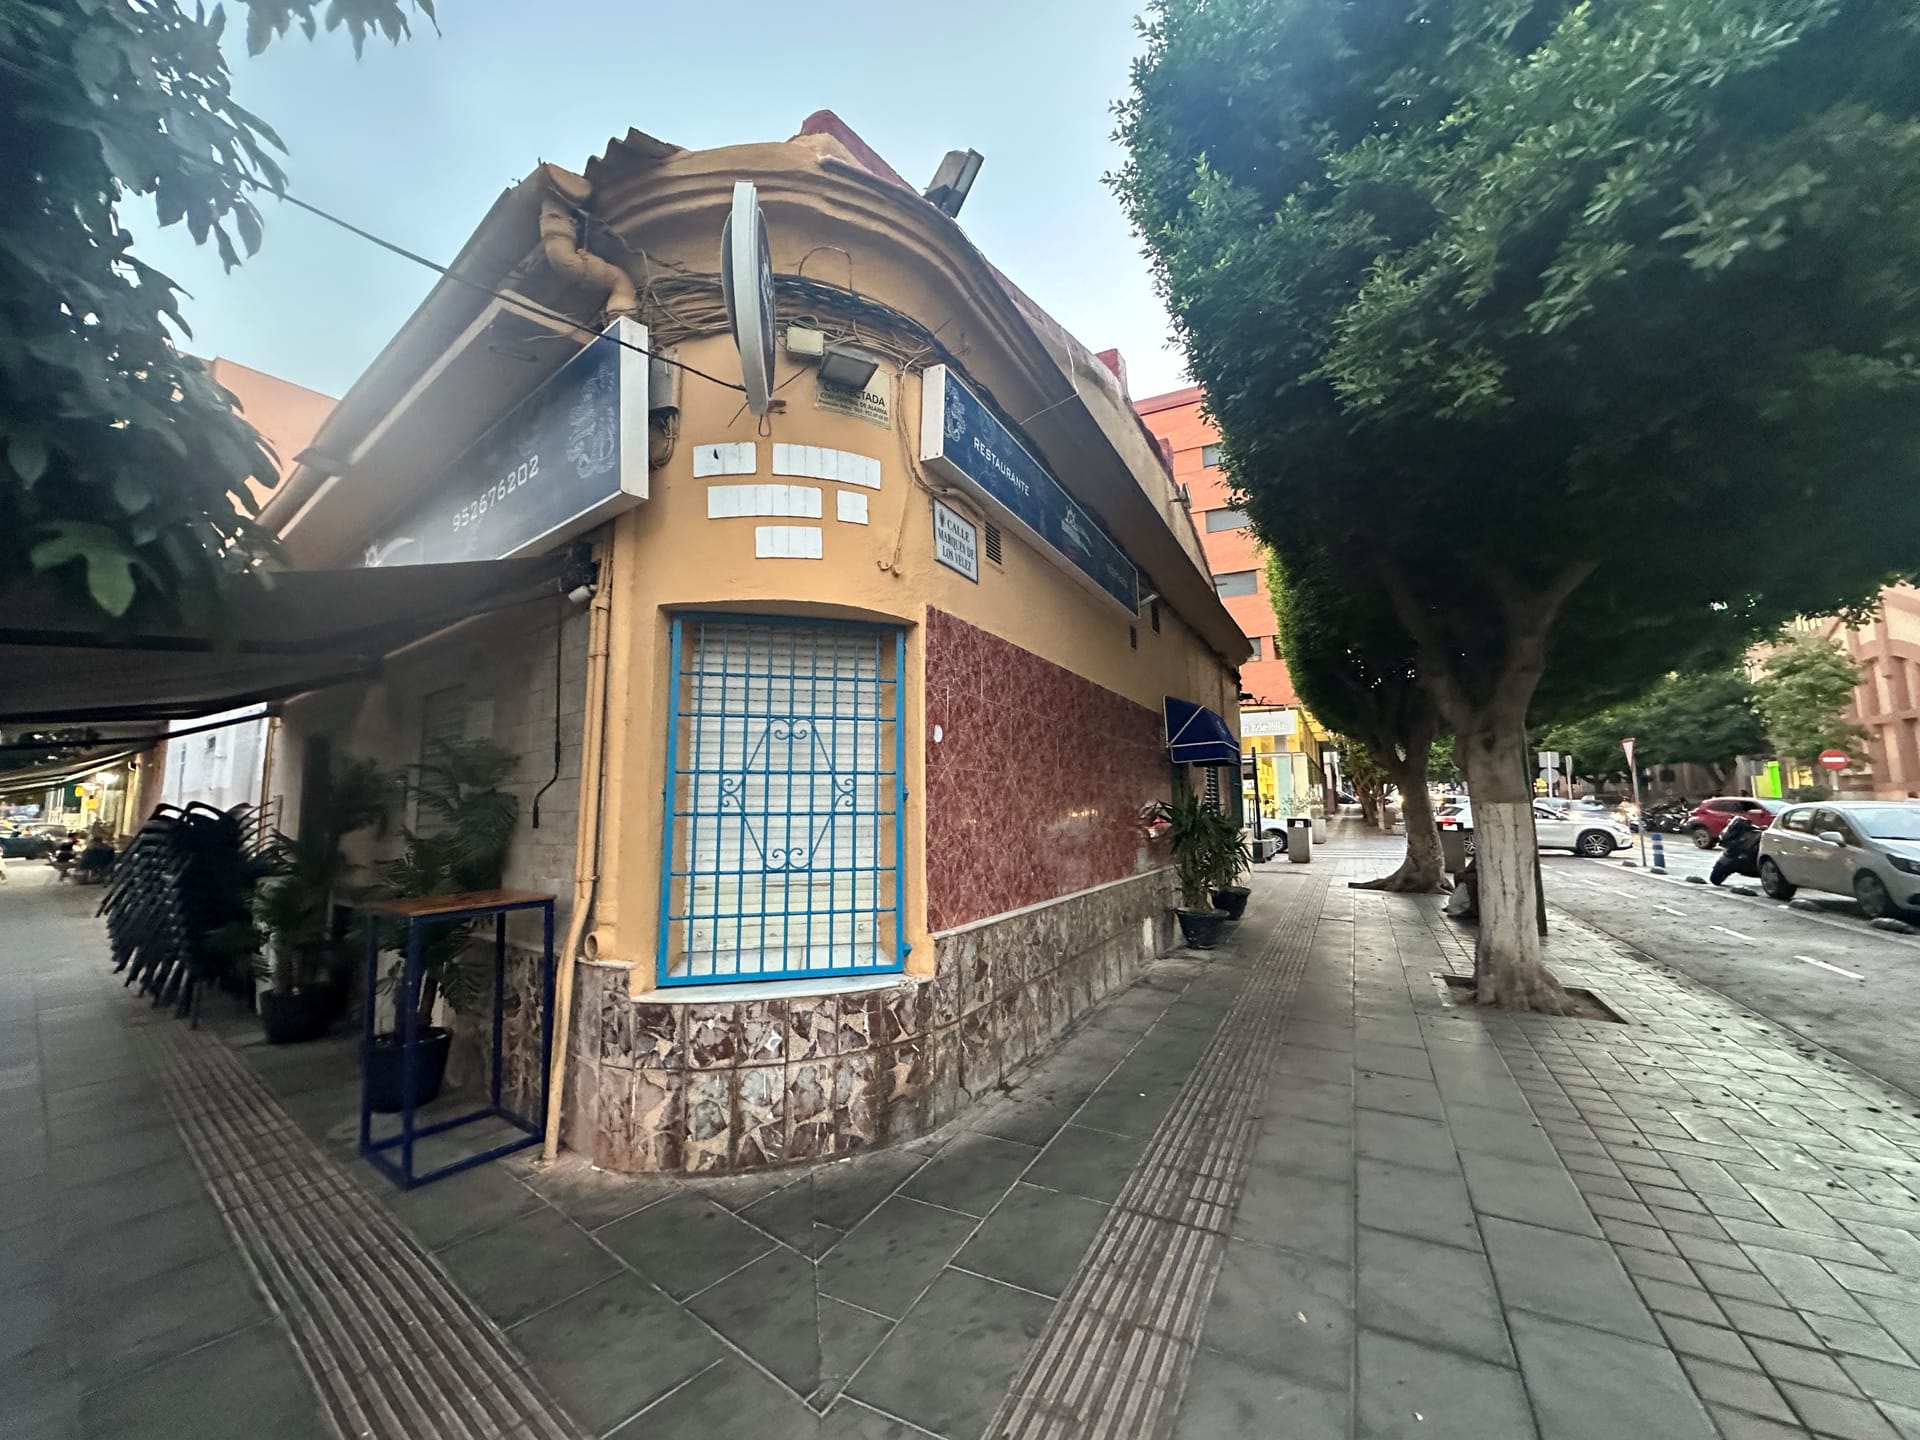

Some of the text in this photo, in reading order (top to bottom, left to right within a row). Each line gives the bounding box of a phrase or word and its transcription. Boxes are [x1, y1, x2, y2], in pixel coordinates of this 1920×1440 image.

[973, 436, 1030, 497] RESTAURANTE
[453, 454, 539, 532] 952676202
[947, 519, 970, 543] CALLE
[942, 544, 954, 561] LOS
[966, 546, 975, 560] DE
